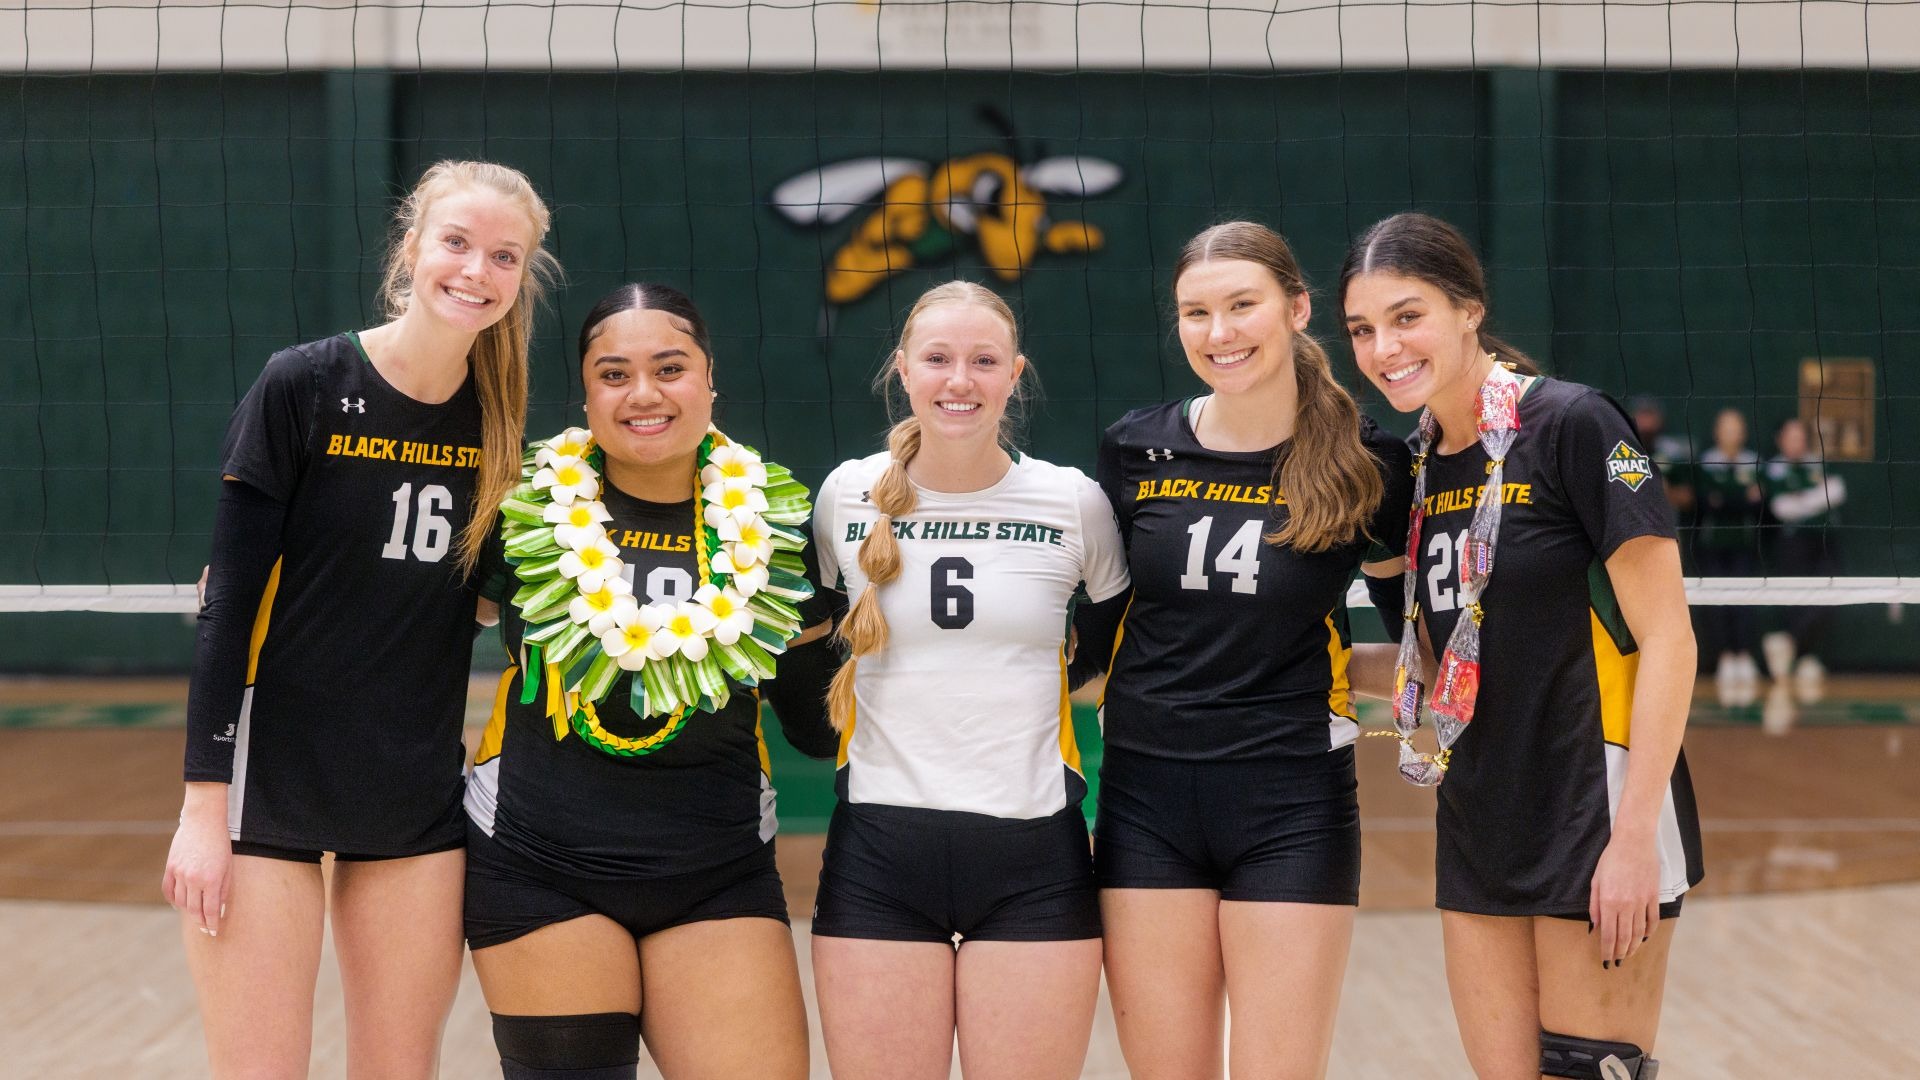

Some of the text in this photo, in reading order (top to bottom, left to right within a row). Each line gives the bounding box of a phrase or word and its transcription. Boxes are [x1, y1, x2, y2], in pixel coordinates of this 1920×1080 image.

[326, 434, 483, 468] BLACK HILLS STA
[1607, 459, 1649, 477] RMAC
[1135, 478, 1204, 501] BLACK
[1203, 482, 1273, 504] HILLS
[1435, 486, 1475, 515] HILLS
[1475, 482, 1532, 508] STE
[381, 482, 453, 563] 16
[845, 521, 1064, 546] BLCK HILLS STATE
[620, 529, 692, 553] HILLS
[1180, 515, 1264, 595] 14
[1427, 528, 1470, 613] 21
[930, 556, 975, 630] 6
